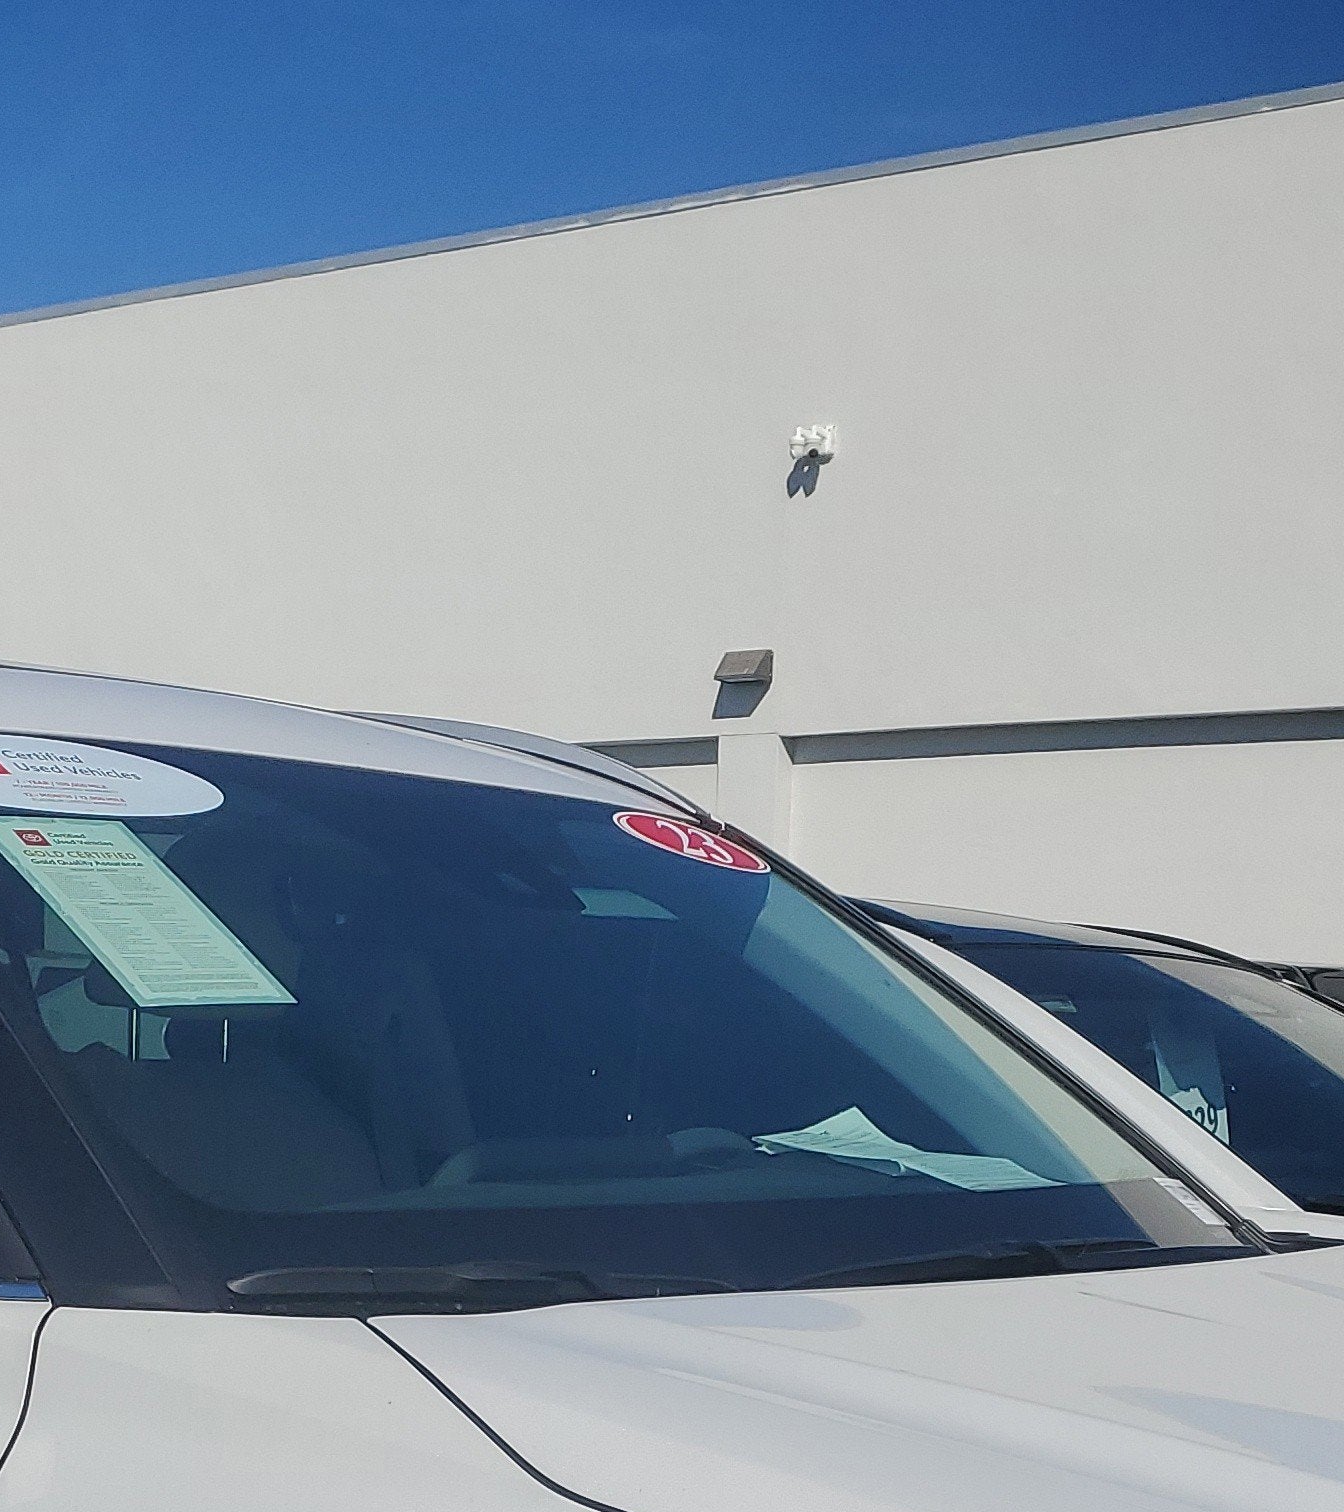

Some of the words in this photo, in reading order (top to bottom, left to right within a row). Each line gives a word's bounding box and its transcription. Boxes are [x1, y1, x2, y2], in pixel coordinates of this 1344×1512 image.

[1, 750, 84, 764] Certified
[13, 762, 64, 774] Used
[64, 765, 142, 781] Vehicles
[656, 820, 734, 864] 23
[23, 849, 64, 859] GOLD
[67, 850, 136, 860] CERTIFIED
[58, 859, 93, 867] Quality
